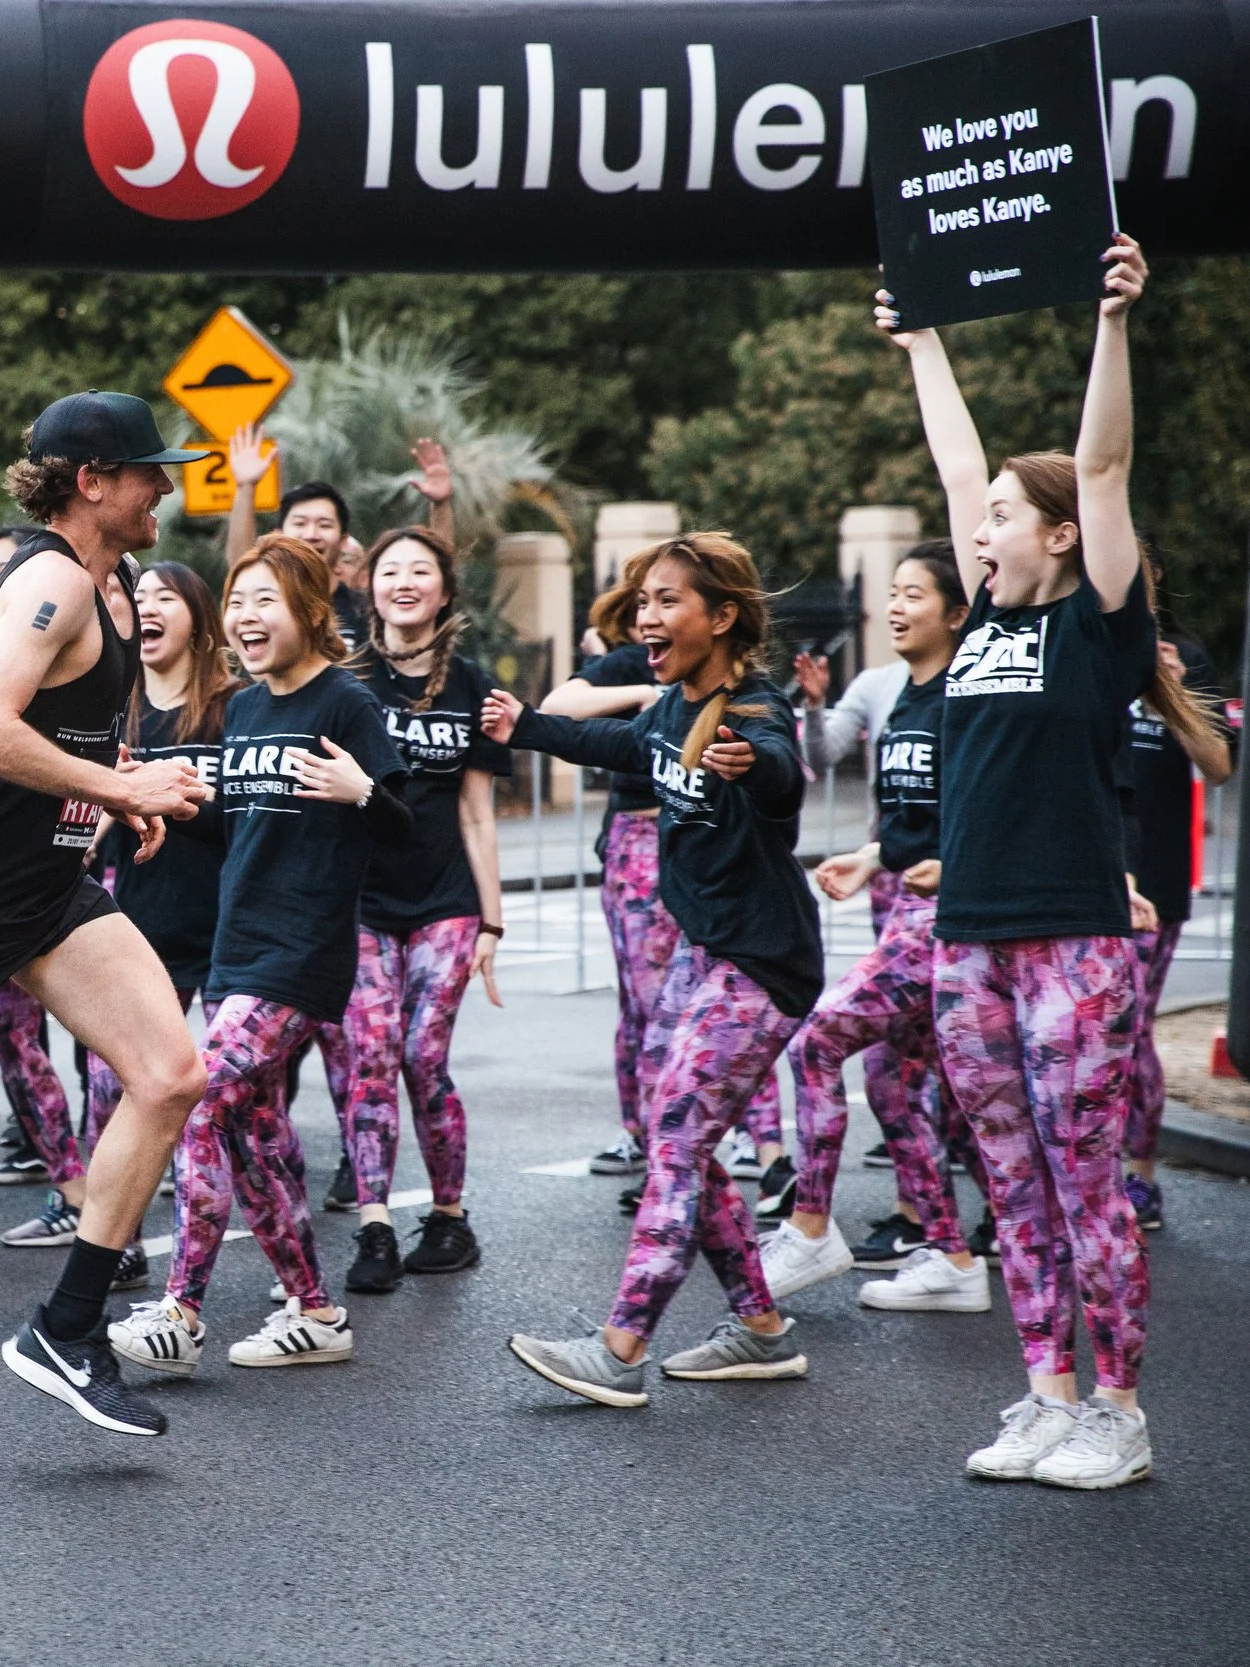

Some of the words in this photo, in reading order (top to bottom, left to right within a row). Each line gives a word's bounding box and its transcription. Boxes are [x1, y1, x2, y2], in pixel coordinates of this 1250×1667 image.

[364, 41, 1198, 193] lululen
[922, 123, 954, 152] We
[955, 117, 997, 145] love
[1000, 107, 1039, 140] you
[900, 176, 924, 199] as
[926, 158, 979, 194] much
[982, 158, 1006, 181] as
[1008, 143, 1073, 174] Kanye
[928, 206, 980, 235] loves
[982, 192, 1051, 223] Kanye.
[387, 711, 471, 748] LARE
[222, 745, 309, 777] LARE
[651, 748, 706, 798] LARE
